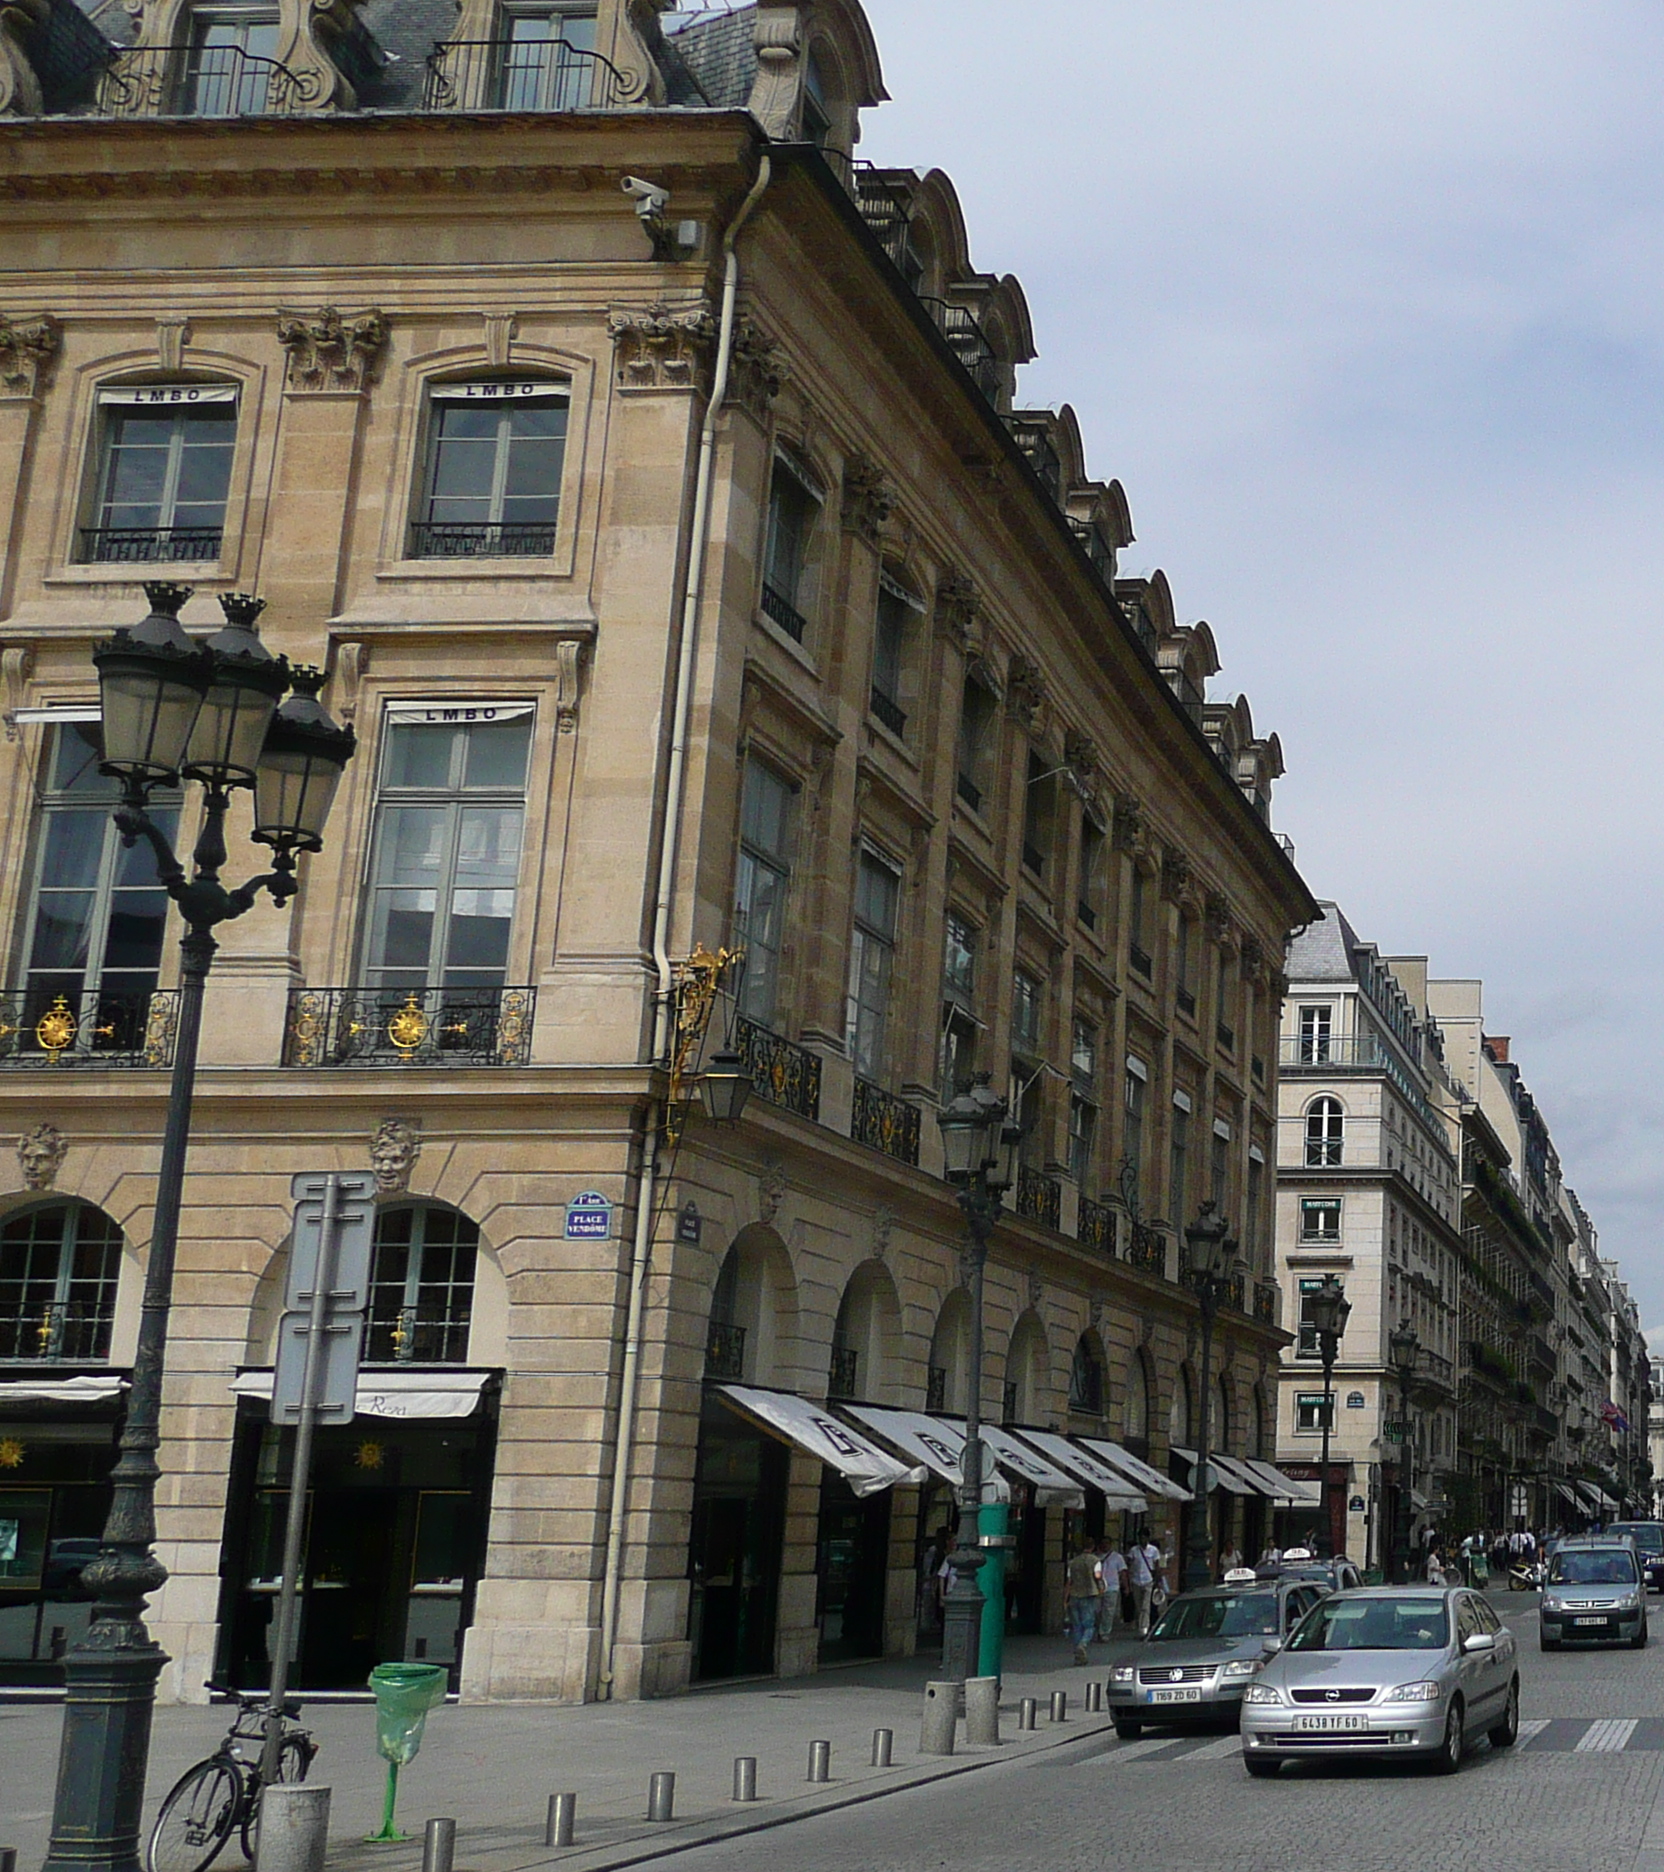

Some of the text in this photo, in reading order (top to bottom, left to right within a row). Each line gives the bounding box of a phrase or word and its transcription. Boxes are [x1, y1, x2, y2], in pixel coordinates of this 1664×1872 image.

[134, 389, 200, 402] LMBO
[466, 384, 534, 396] LMBO
[425, 707, 496, 721] LMBO
[573, 1215, 603, 1223] PLACE
[568, 1223, 606, 1233] VENDÔME
[1186, 1690, 1197, 1700] 60
[1345, 1716, 1358, 1728] 60
